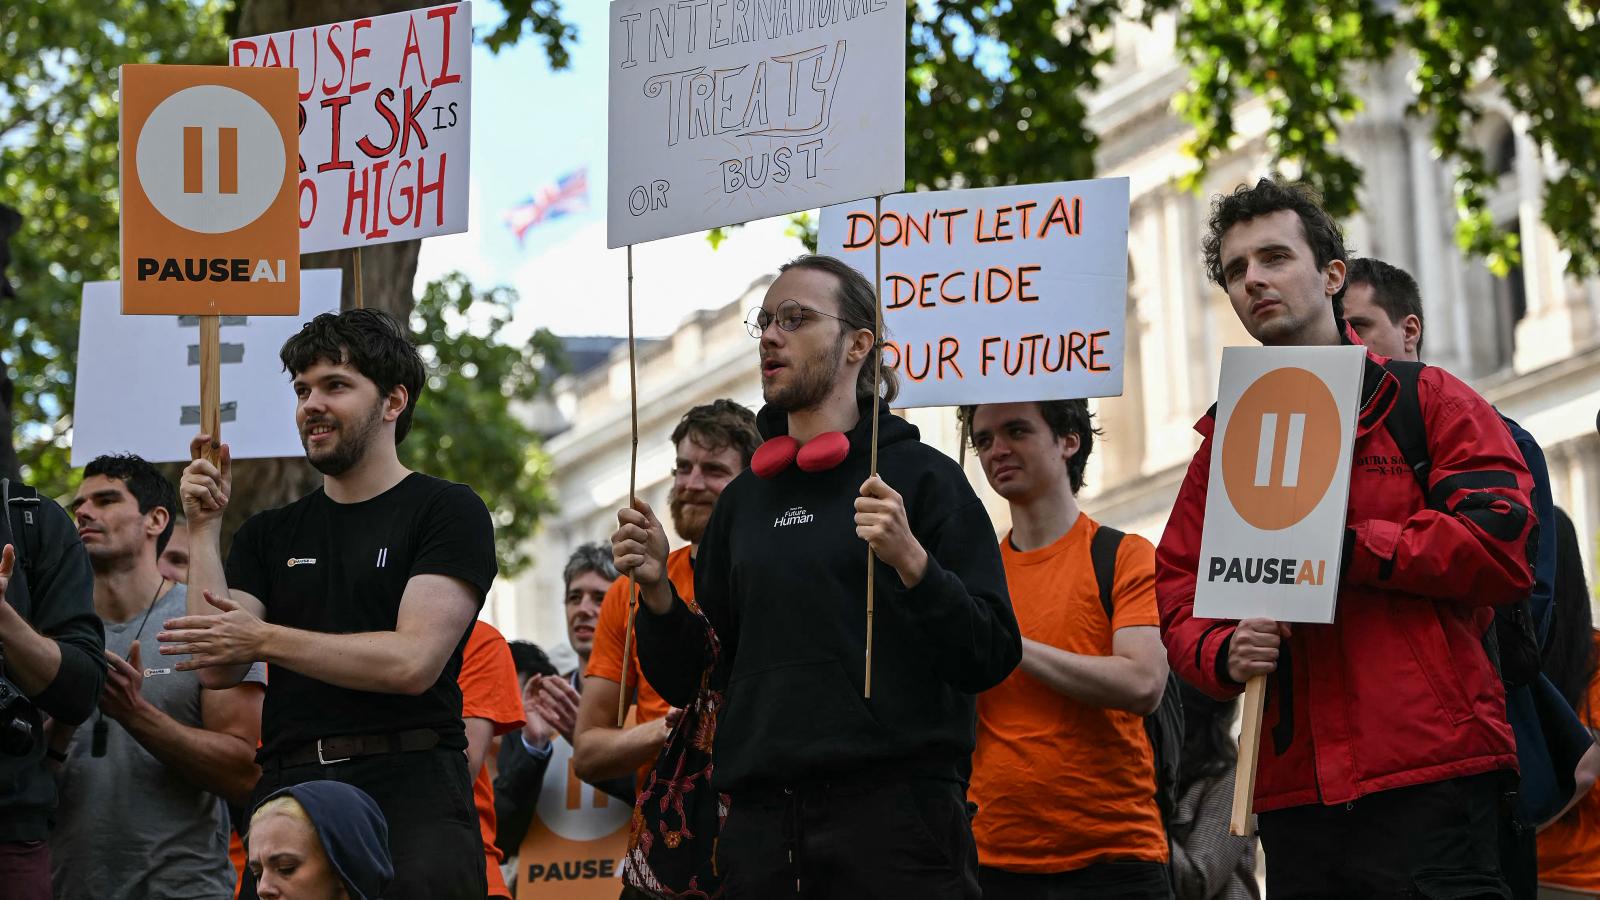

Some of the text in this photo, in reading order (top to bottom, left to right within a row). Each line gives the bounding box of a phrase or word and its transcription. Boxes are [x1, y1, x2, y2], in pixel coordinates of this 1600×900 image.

[398, 6, 462, 89] AI
[619, 0, 888, 69] INTERNATION
[432, 102, 458, 130] IS
[643, 39, 847, 147] TREATY
[342, 152, 448, 241] HIGH
[628, 138, 824, 216] OR BUST
[842, 195, 1083, 250] DON'T LET AI
[884, 265, 1042, 310] DECIDE
[980, 330, 1111, 377] FUTURE
[773, 514, 813, 527] Human
[528, 858, 624, 883] PAUSE
